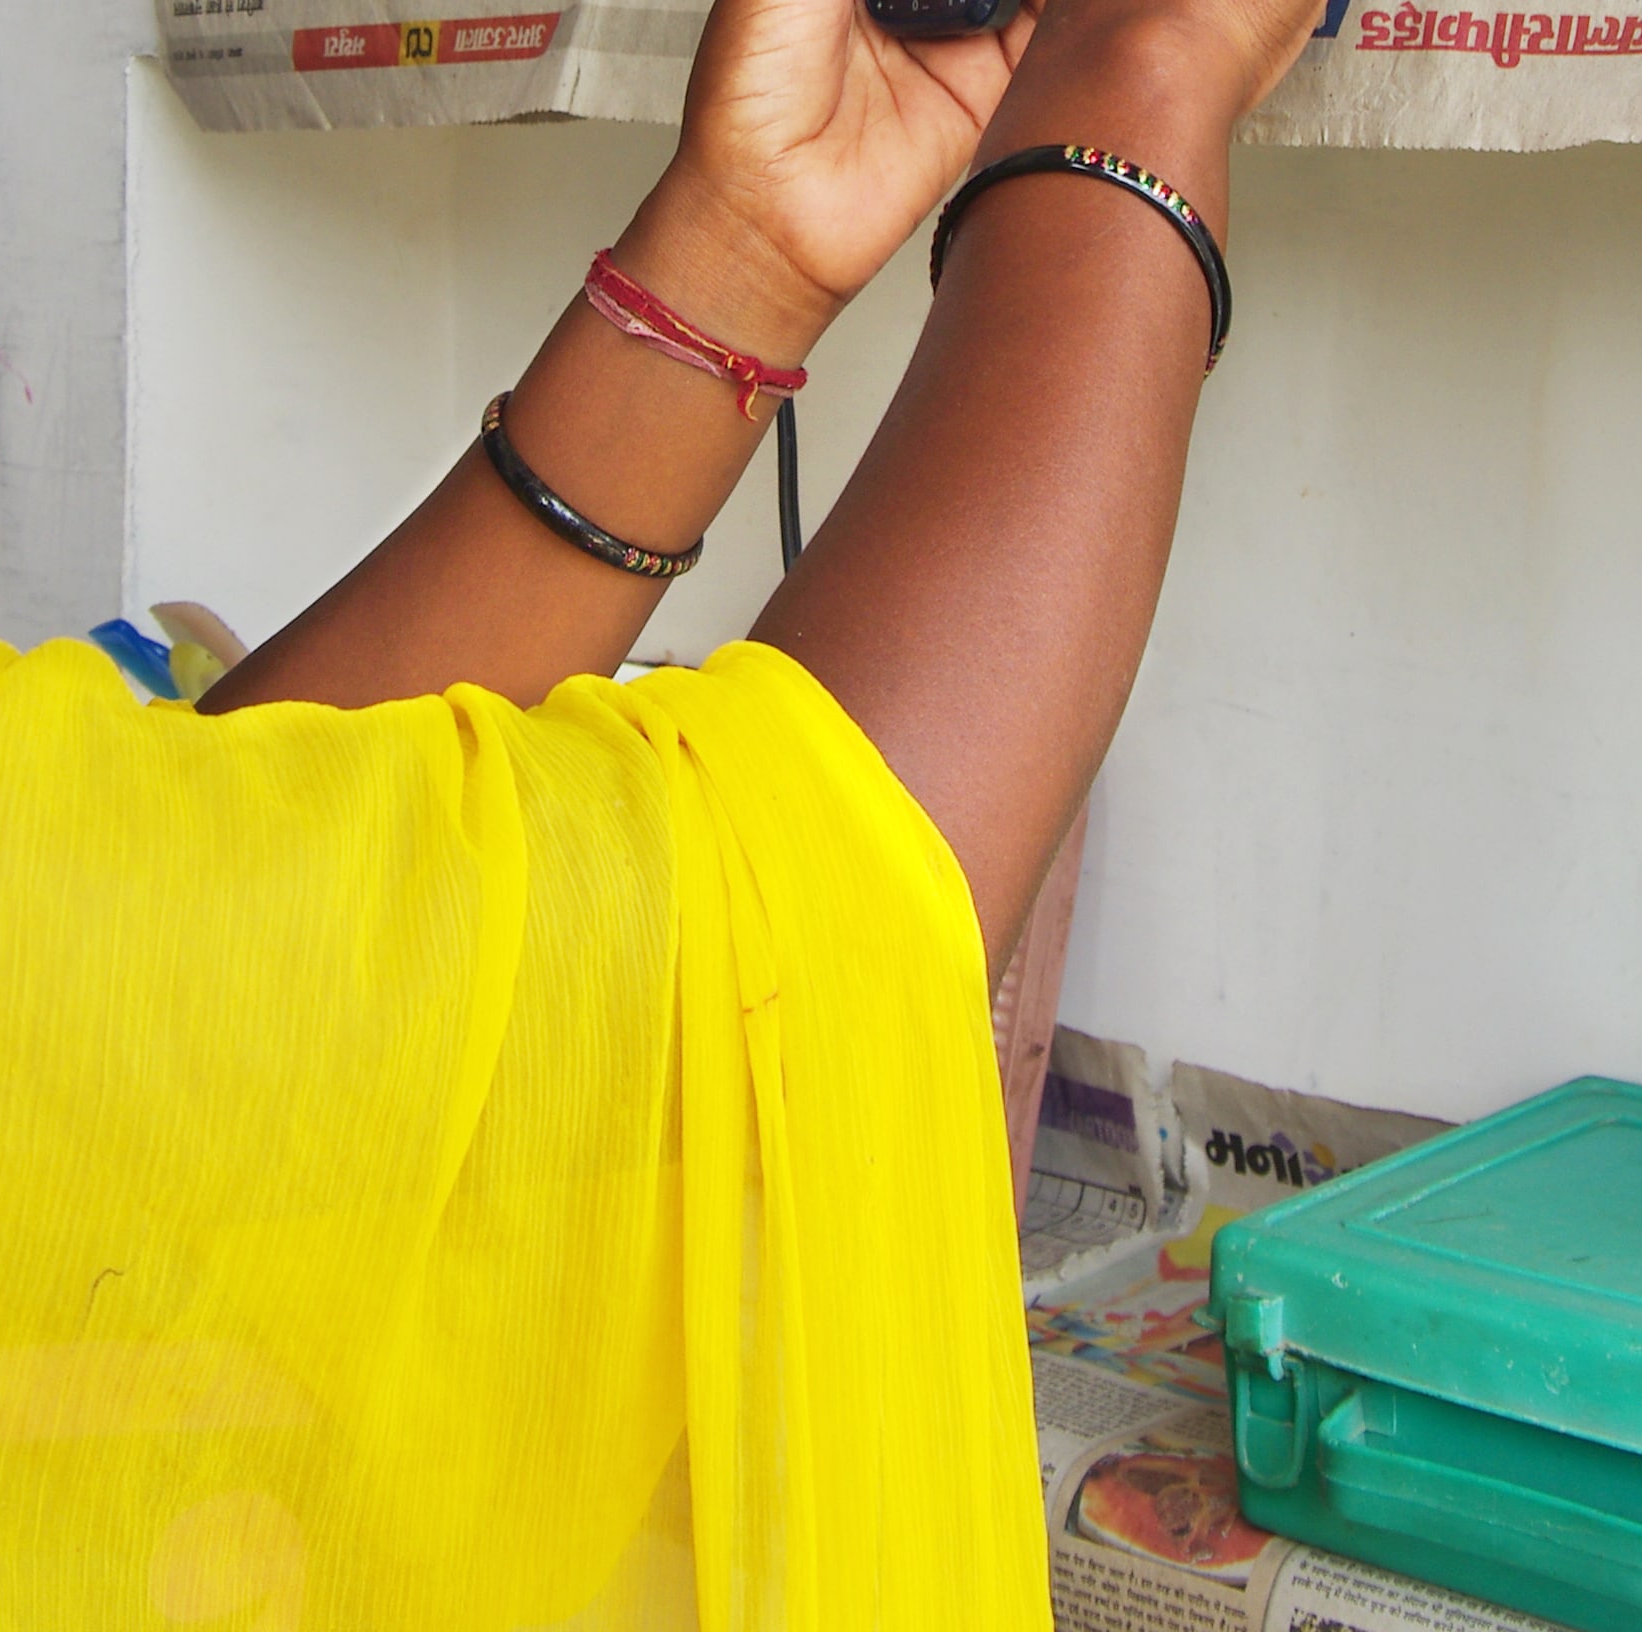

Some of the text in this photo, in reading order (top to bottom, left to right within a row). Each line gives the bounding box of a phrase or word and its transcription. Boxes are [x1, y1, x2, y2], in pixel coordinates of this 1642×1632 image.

[912, 0, 918, 11] 0
[324, 29, 365, 57] मथुरा
[454, 26, 503, 52] उजाला
[507, 24, 546, 49] अमर
